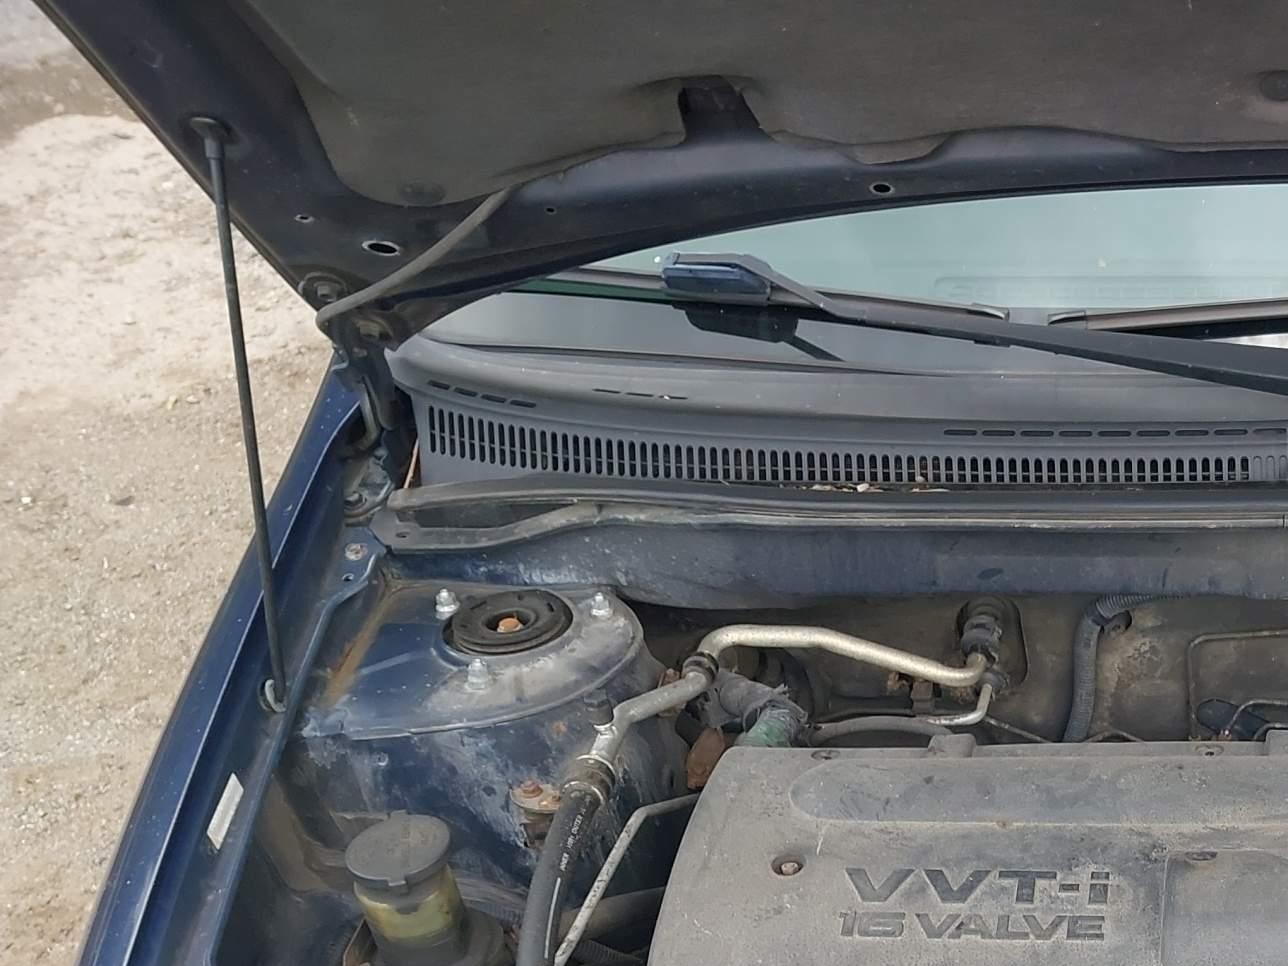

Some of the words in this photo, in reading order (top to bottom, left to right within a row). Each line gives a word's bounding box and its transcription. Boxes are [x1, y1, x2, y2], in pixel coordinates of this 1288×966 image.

[845, 867, 1111, 904] VVT-i
[839, 911, 906, 938] 16
[914, 913, 1105, 941] VALVE
